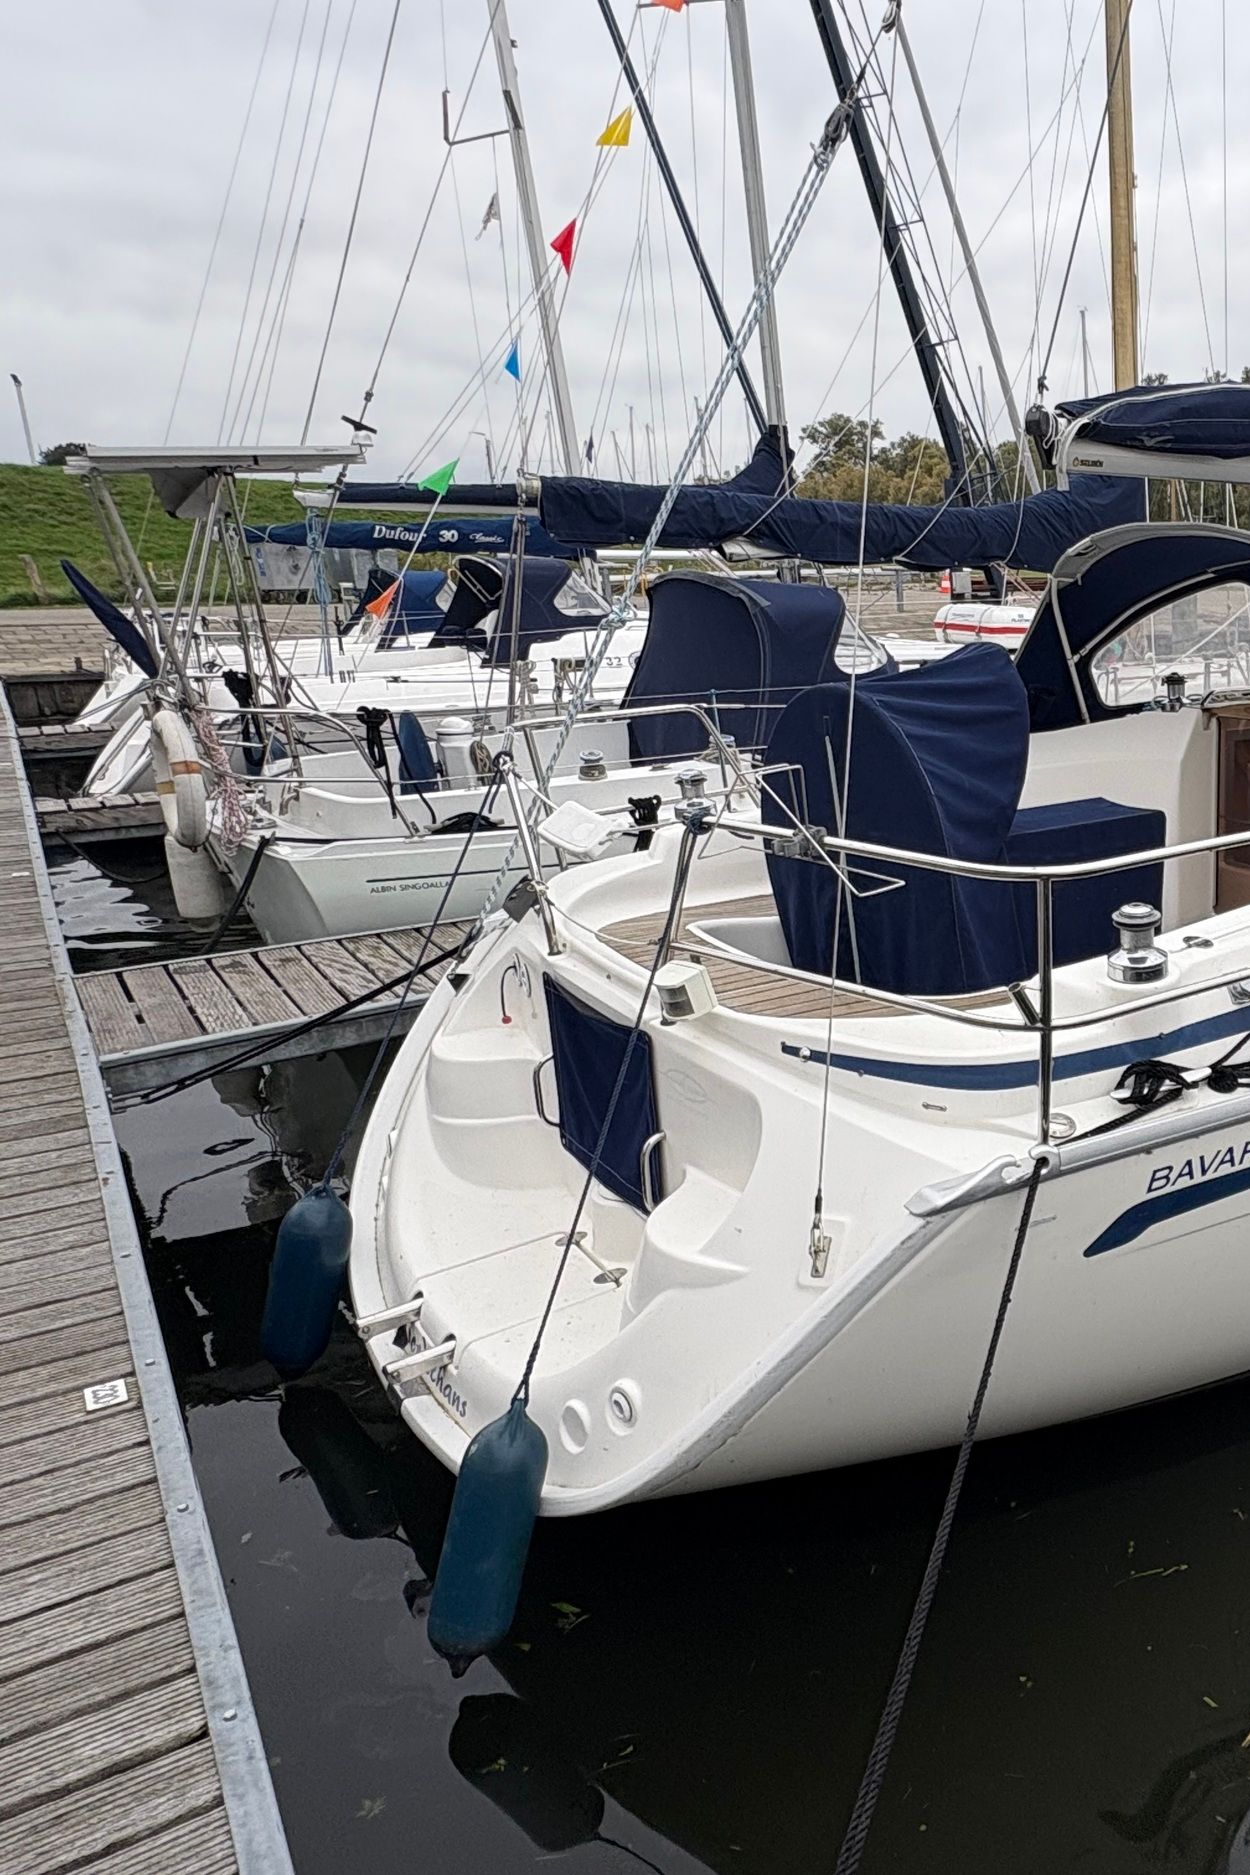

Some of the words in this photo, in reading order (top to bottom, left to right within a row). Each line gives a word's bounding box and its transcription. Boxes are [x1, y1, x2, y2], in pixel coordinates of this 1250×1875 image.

[373, 525, 427, 541] Dufour
[439, 530, 458, 542] 30
[370, 885, 397, 894] ALBIN
